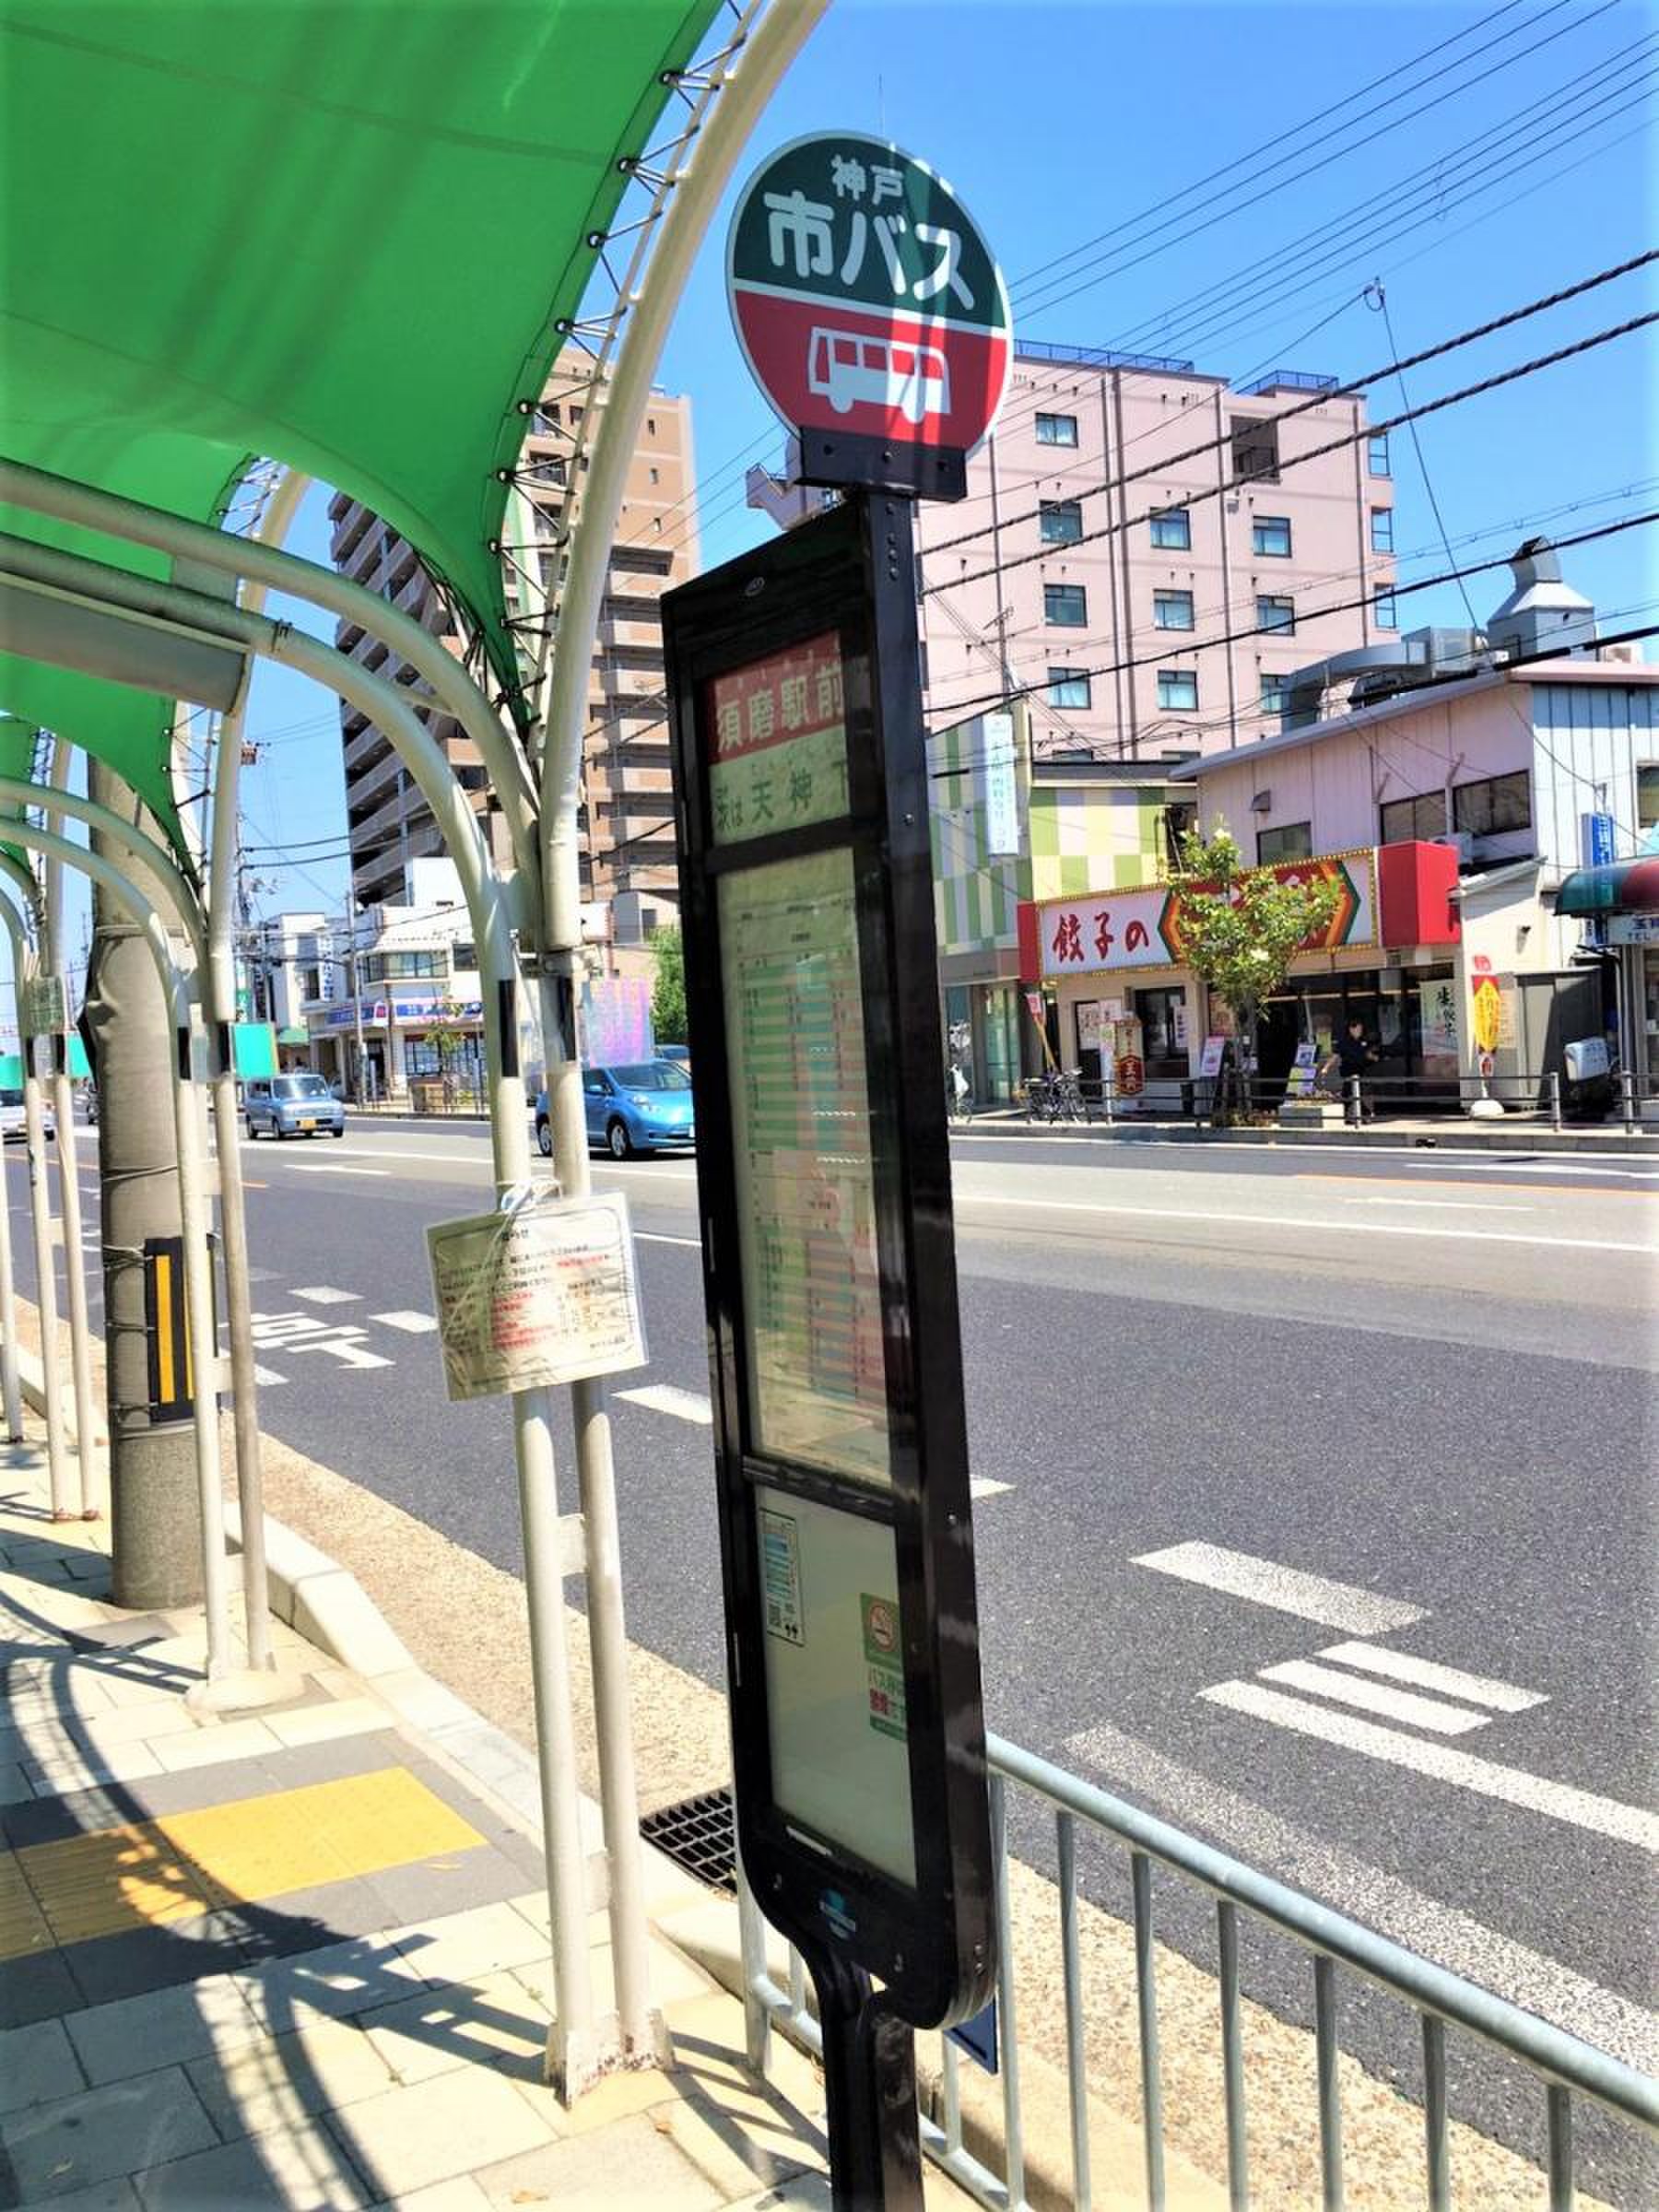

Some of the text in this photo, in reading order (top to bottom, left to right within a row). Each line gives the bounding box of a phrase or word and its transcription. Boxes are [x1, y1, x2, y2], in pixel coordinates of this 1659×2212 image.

[831, 154, 904, 206] 神戸
[763, 191, 975, 310] 市バス
[716, 659, 844, 754] 須磨駅前
[1053, 911, 1150, 962] 餃子の
